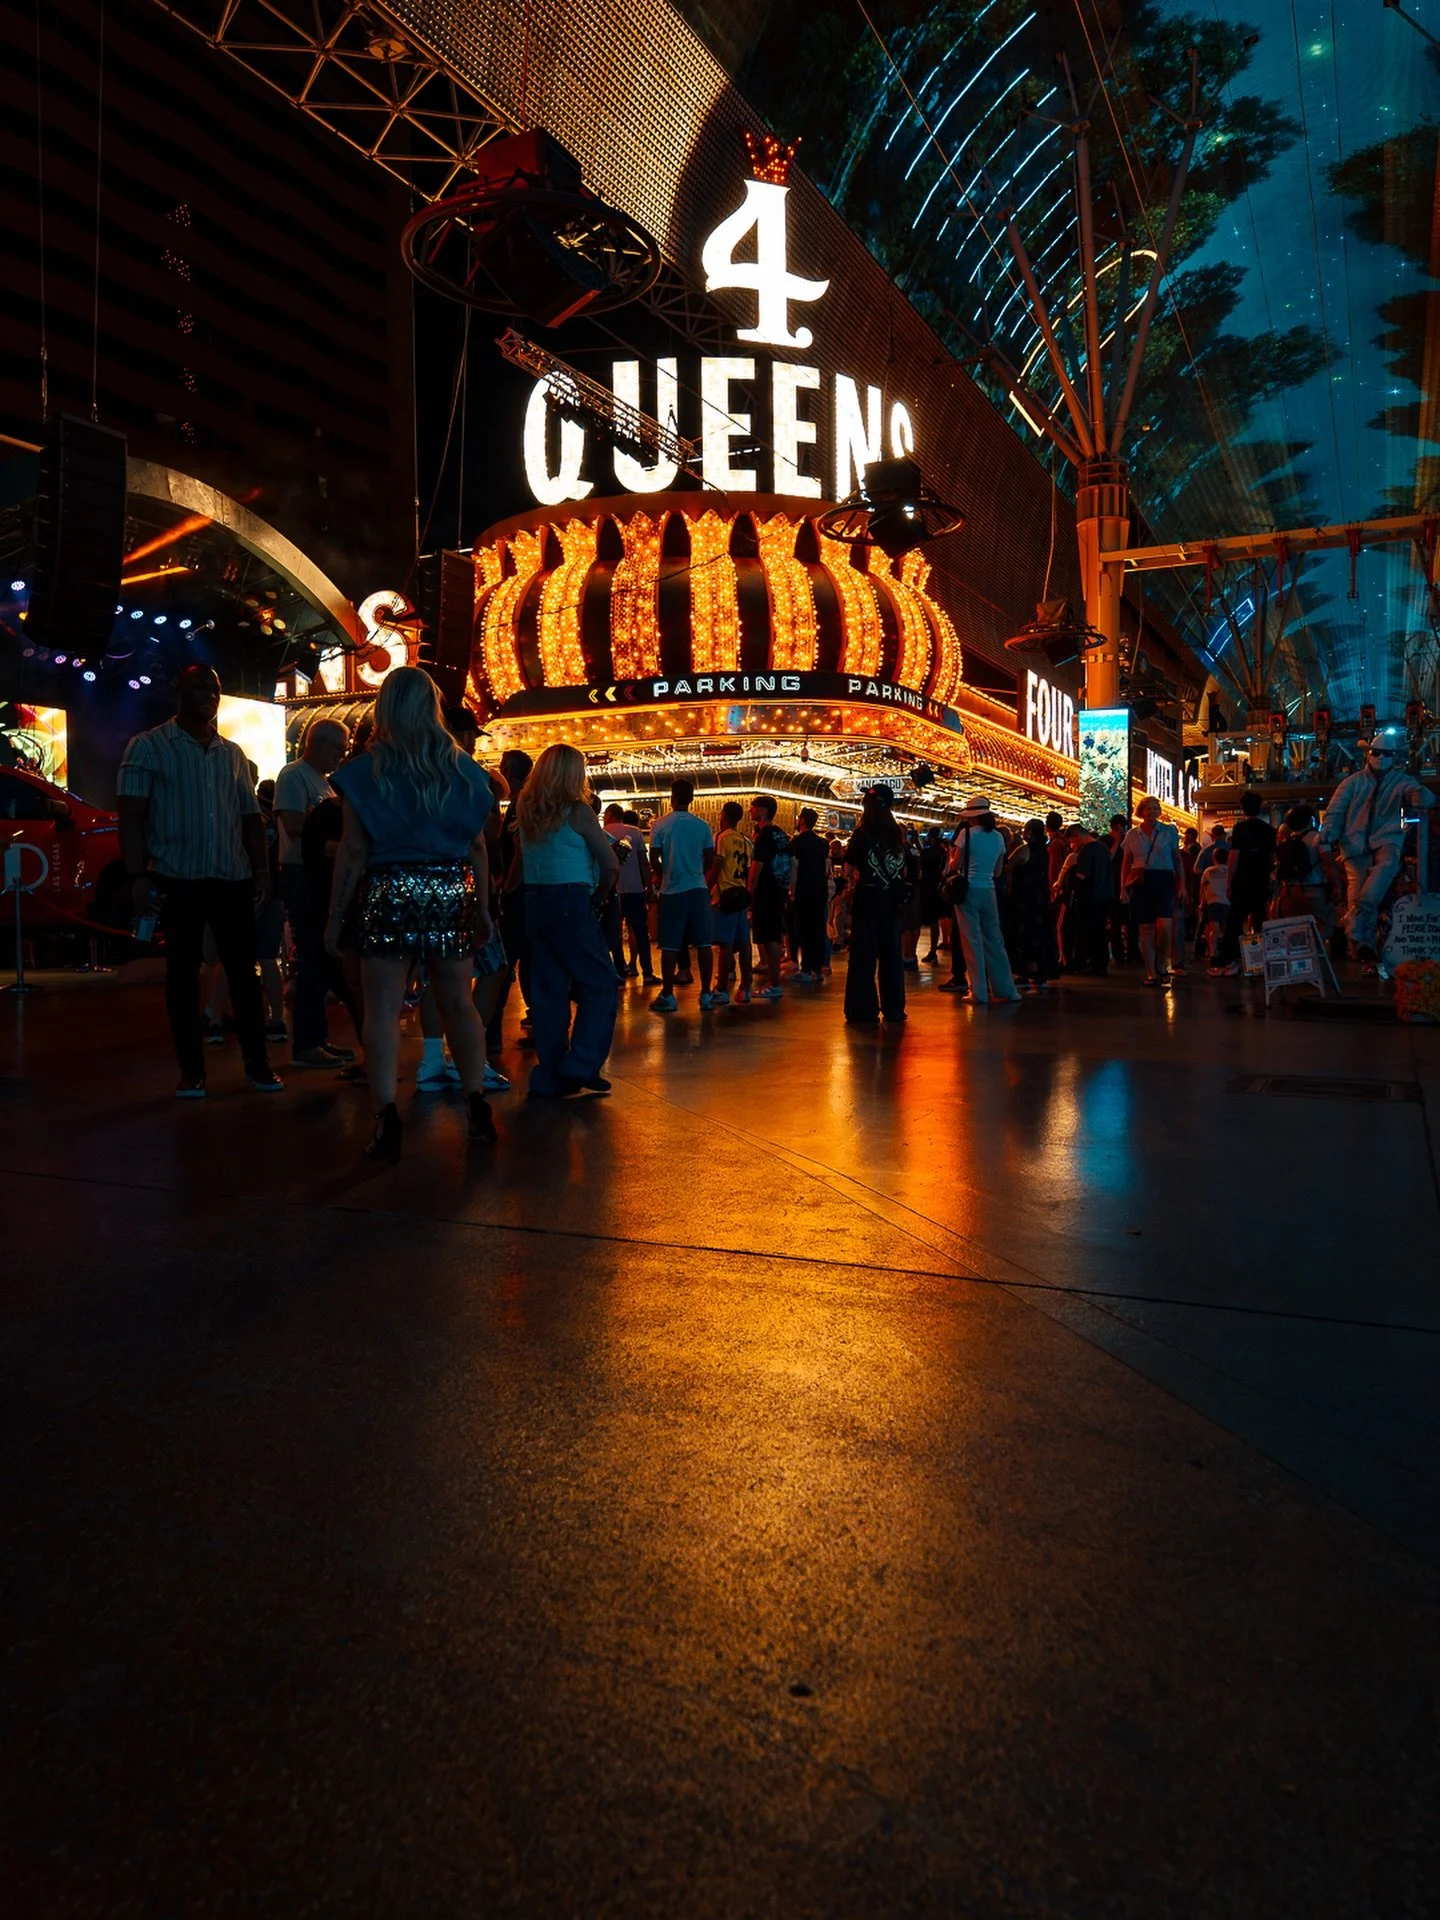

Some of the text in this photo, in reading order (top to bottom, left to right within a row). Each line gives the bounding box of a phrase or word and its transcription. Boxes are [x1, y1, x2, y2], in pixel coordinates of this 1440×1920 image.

[701, 179, 830, 349] 4
[653, 675, 801, 698] PARKING
[848, 679, 924, 711] PARKING
[1026, 668, 1075, 759] FOUR
